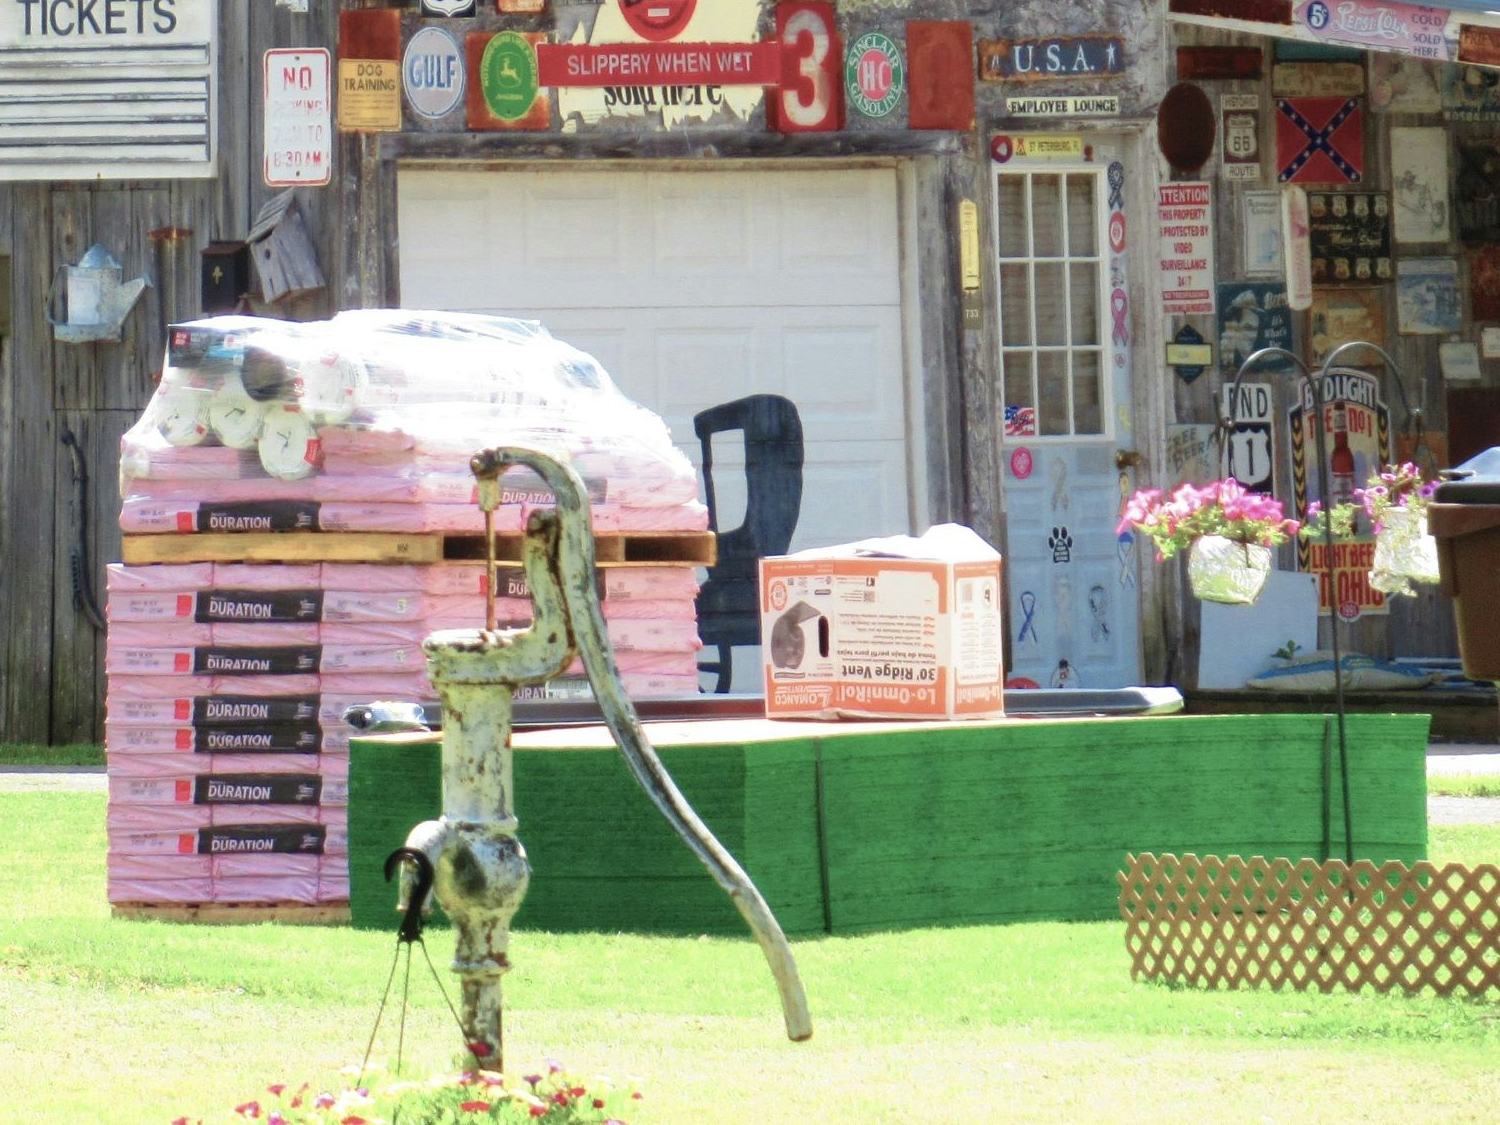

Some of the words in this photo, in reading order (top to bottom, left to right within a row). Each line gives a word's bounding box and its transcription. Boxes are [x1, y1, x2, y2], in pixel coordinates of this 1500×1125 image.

[1411, 13, 1442, 26] COLD
[1412, 33, 1441, 45] SOLD
[850, 34, 900, 71] SINCLAIR
[1013, 44, 1096, 73] U.S.A.
[1413, 46, 1439, 57] HERE
[357, 63, 383, 76] DOG
[568, 53, 650, 75] SLIPPERY
[655, 52, 711, 74] WHEN
[717, 51, 753, 72] WET
[783, 9, 830, 126] 3
[283, 66, 312, 92] NO
[410, 54, 457, 89] GULF
[344, 77, 397, 91] TRAINING
[850, 81, 901, 115] GASOLINE
[1011, 101, 1067, 114] EMPLOYEE
[1074, 100, 1117, 113] LOUNGE
[1233, 135, 1250, 152] 66
[1229, 166, 1255, 177] ROUTE
[1172, 209, 1205, 220] PROPERTY
[1164, 226, 1200, 237] PROTECTED
[1200, 225, 1209, 236] BY
[1174, 242, 1193, 254] VIDEO
[1160, 259, 1207, 270] SURVEILLANCE
[1335, 377, 1376, 409] LIGHT
[1246, 438, 1255, 476] 1
[210, 517, 271, 529] DURATION
[209, 603, 272, 618] DURATION
[207, 658, 270, 670] DURATION
[841, 665, 873, 679] Vent
[874, 664, 913, 680] Ridge
[912, 666, 936, 681] 30'
[775, 692, 830, 708] LOMANCO
[835, 685, 936, 705] Lo-OmniRoll
[206, 703, 268, 718] DURATION
[207, 734, 272, 748] DURATION
[207, 784, 271, 800] DURATION
[211, 839, 274, 852] DURATION
